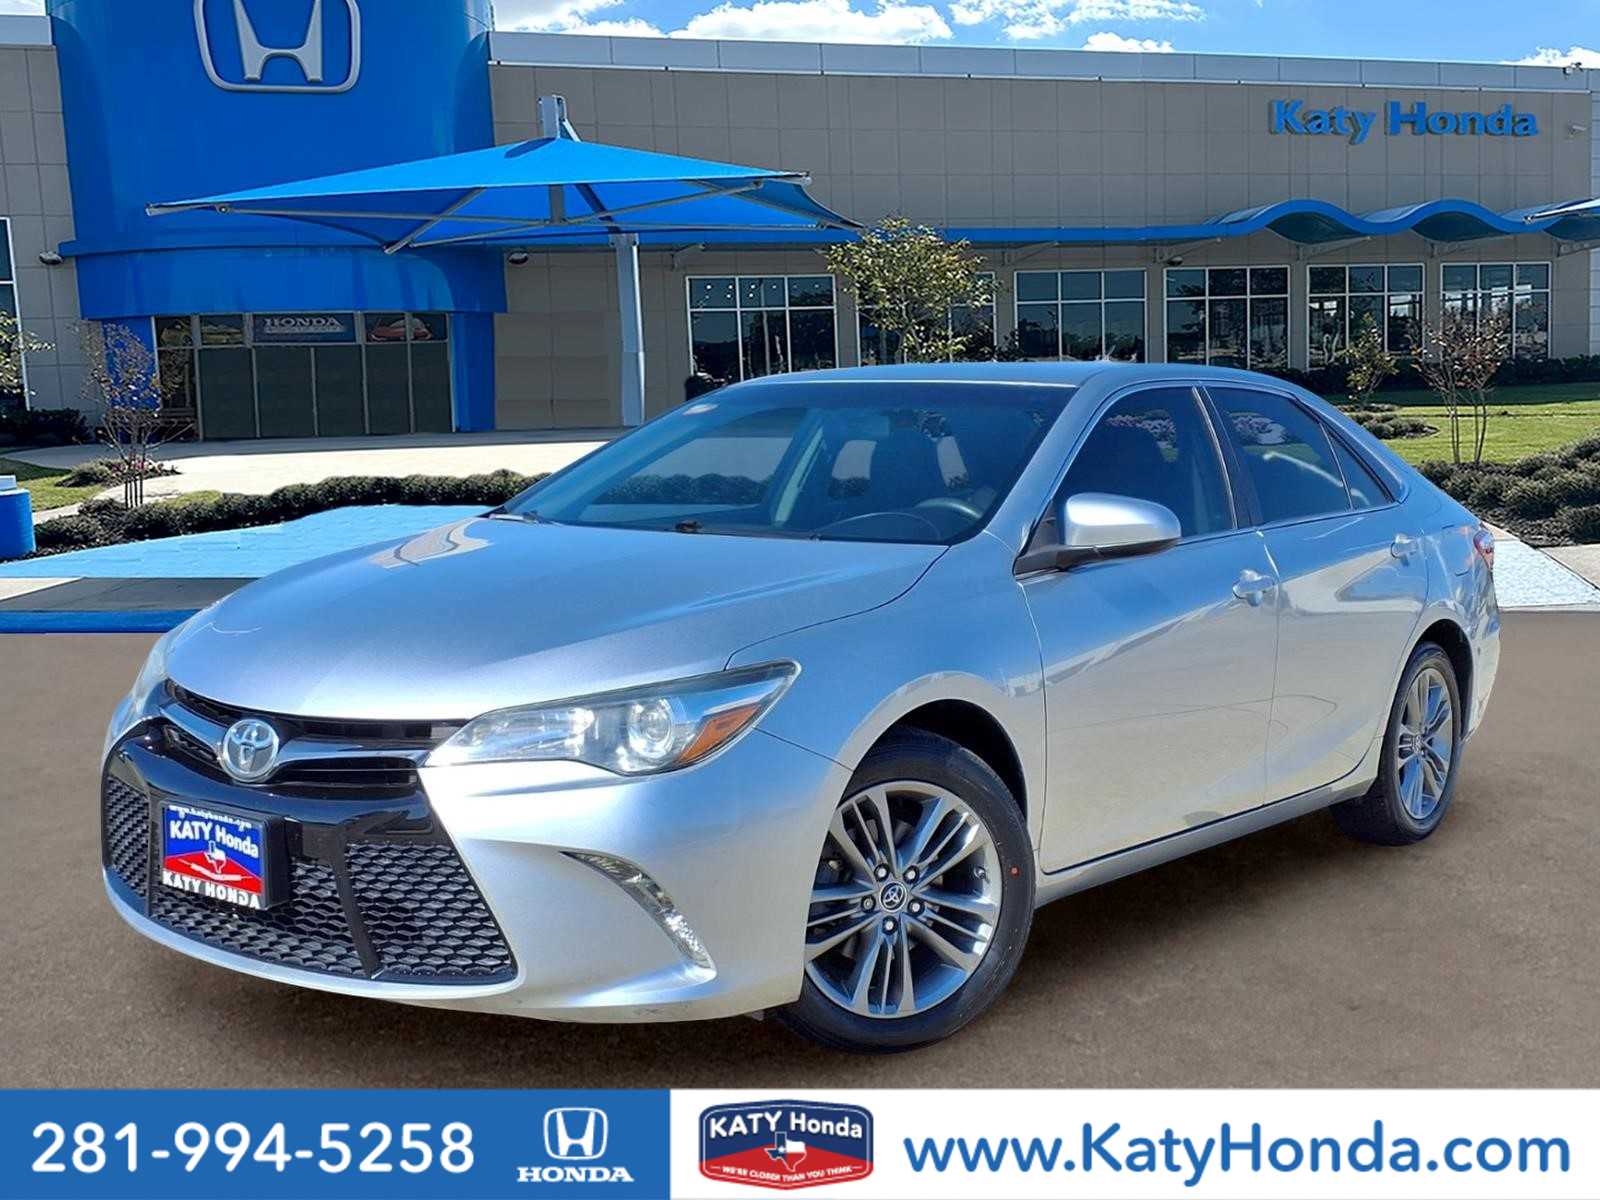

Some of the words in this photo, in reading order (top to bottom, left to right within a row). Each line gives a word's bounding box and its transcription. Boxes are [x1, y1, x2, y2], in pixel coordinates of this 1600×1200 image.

[1269, 100, 1376, 145] Katy
[1384, 100, 1539, 137] Honda
[263, 316, 343, 328] HONDA
[169, 820, 213, 840] KATY
[215, 824, 259, 858] Honda
[162, 870, 204, 893] KATY
[205, 882, 260, 910] HONDA
